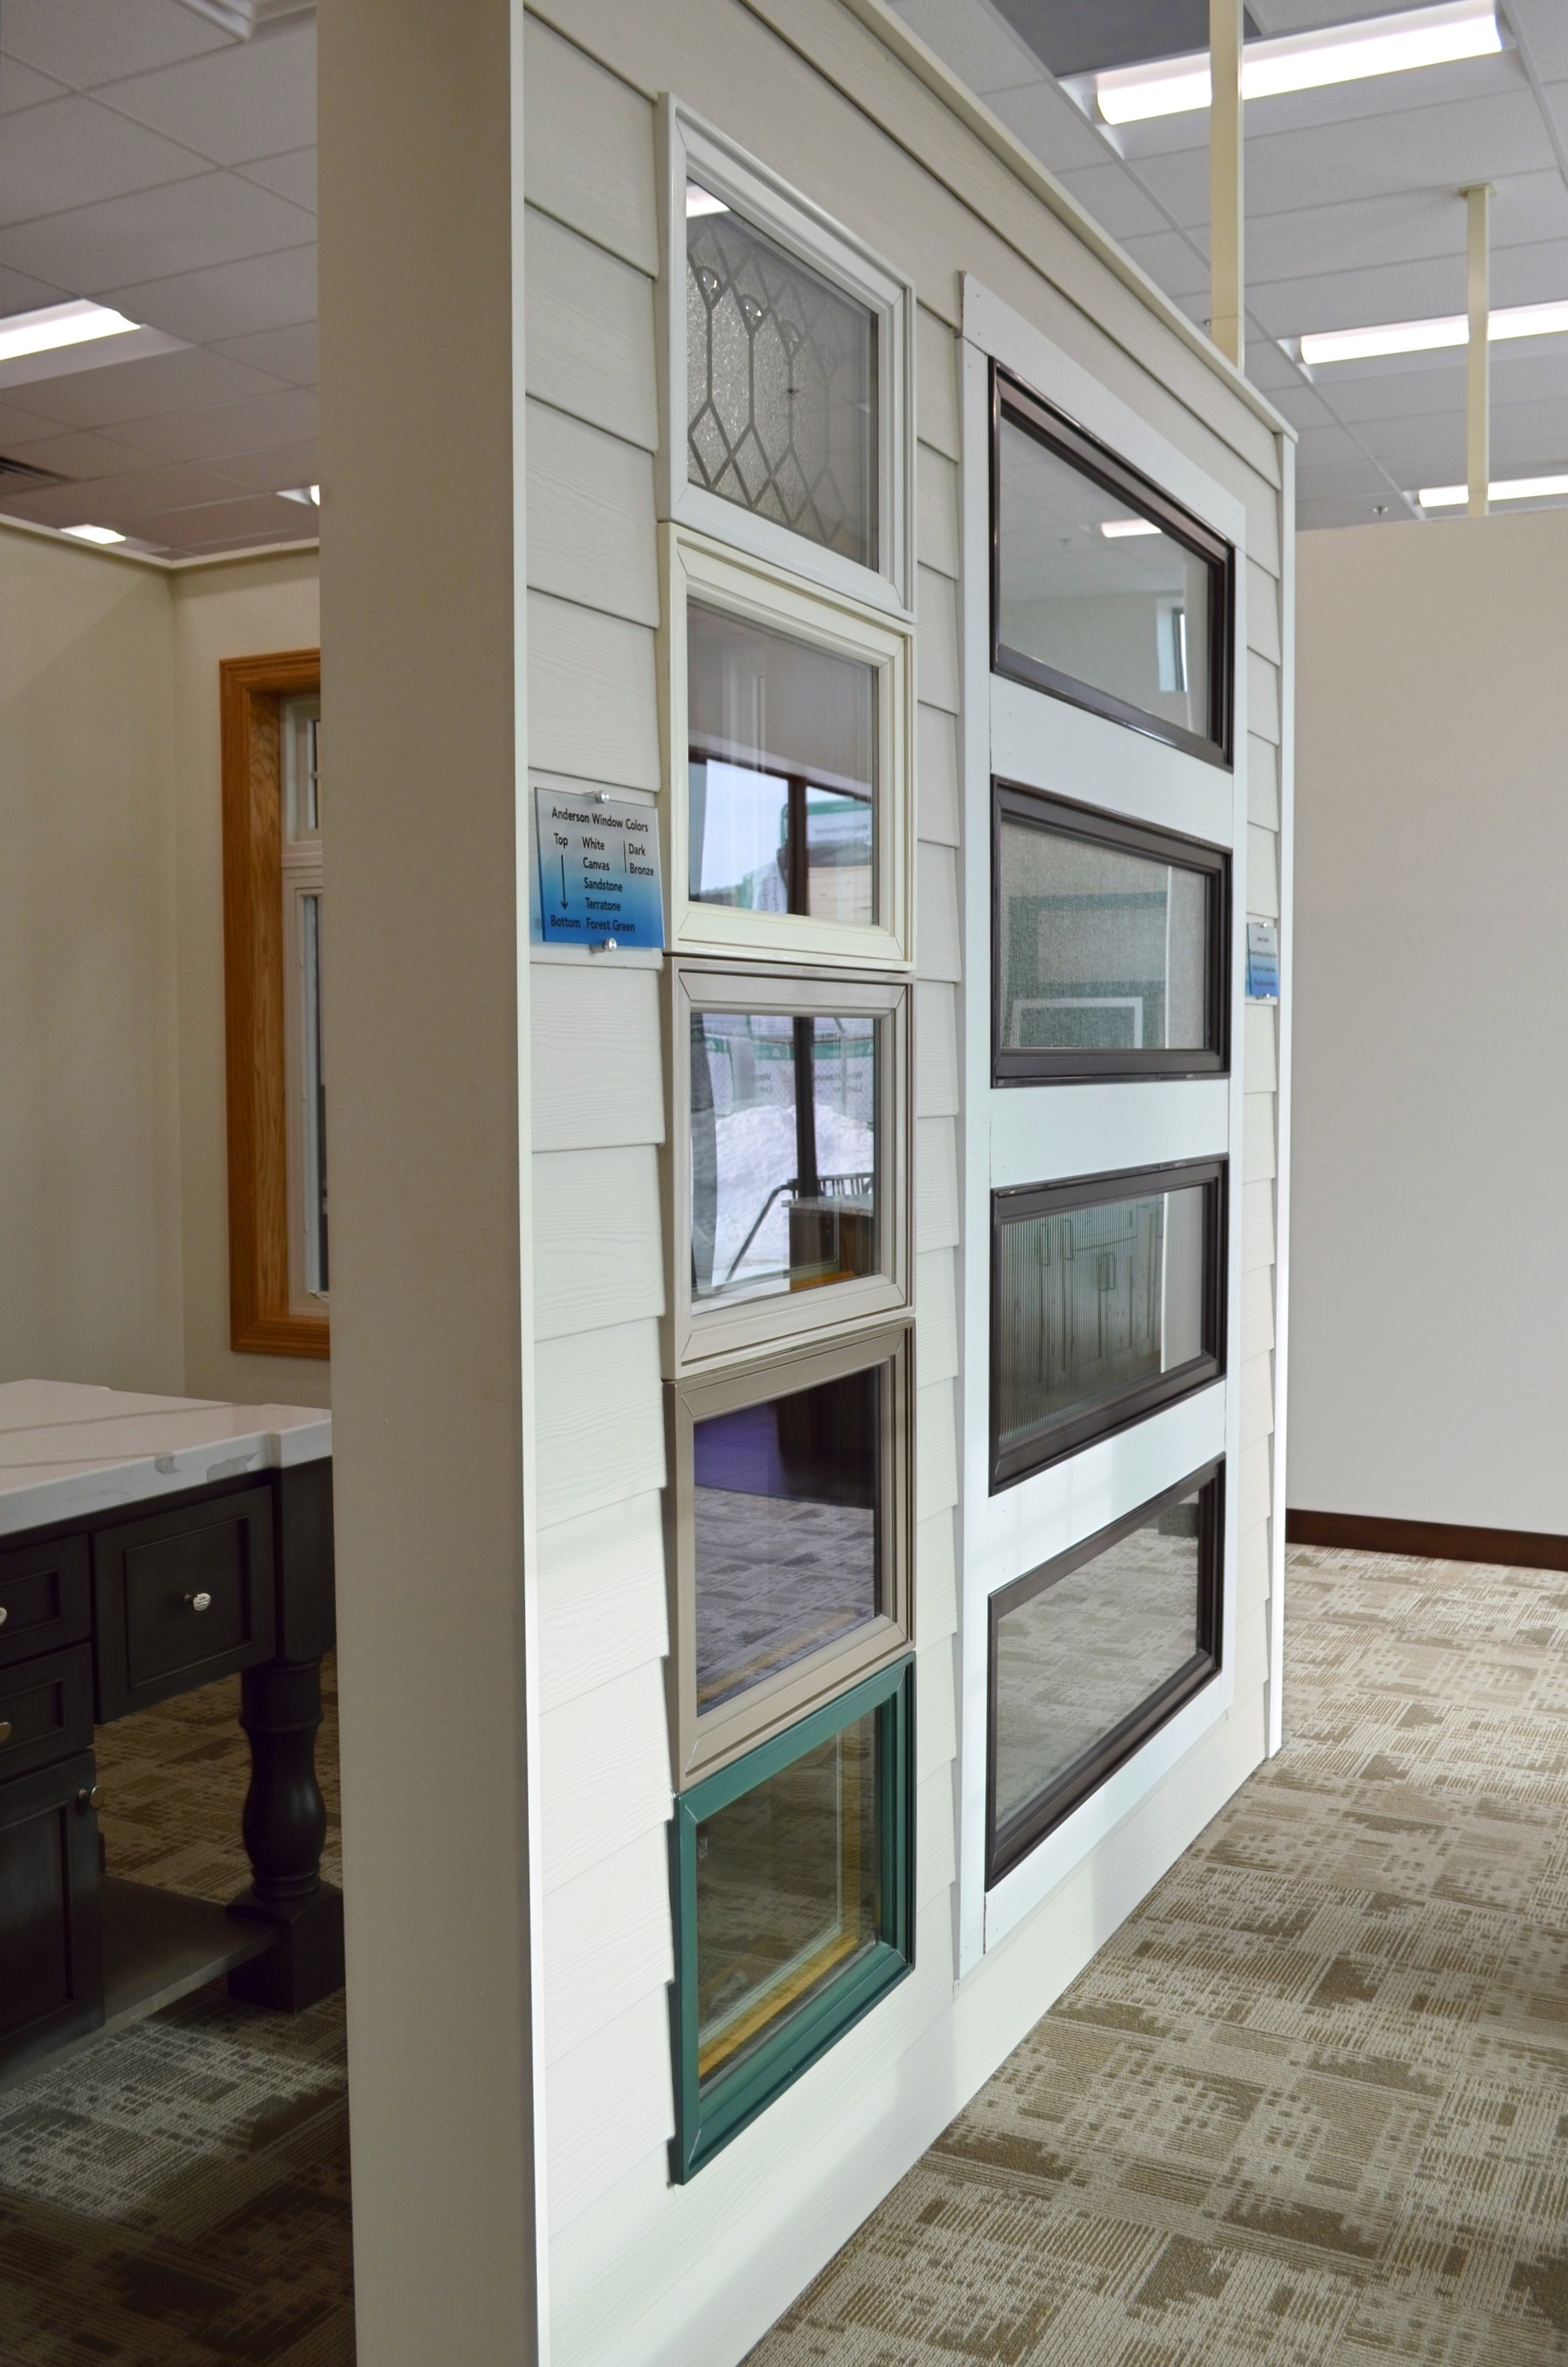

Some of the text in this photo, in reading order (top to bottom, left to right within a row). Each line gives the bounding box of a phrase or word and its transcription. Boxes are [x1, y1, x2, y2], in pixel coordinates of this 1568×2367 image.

[551, 807, 648, 833] Anderson Window Colors
[554, 833, 568, 849] Top
[582, 837, 605, 851] White
[629, 843, 646, 857] Dark
[583, 857, 610, 871] Canvas
[630, 863, 654, 876] Bronze
[584, 877, 623, 892] Sandstone
[585, 897, 621, 912] Terratone
[551, 914, 580, 929] Bottom
[587, 917, 635, 933] Forest Green
